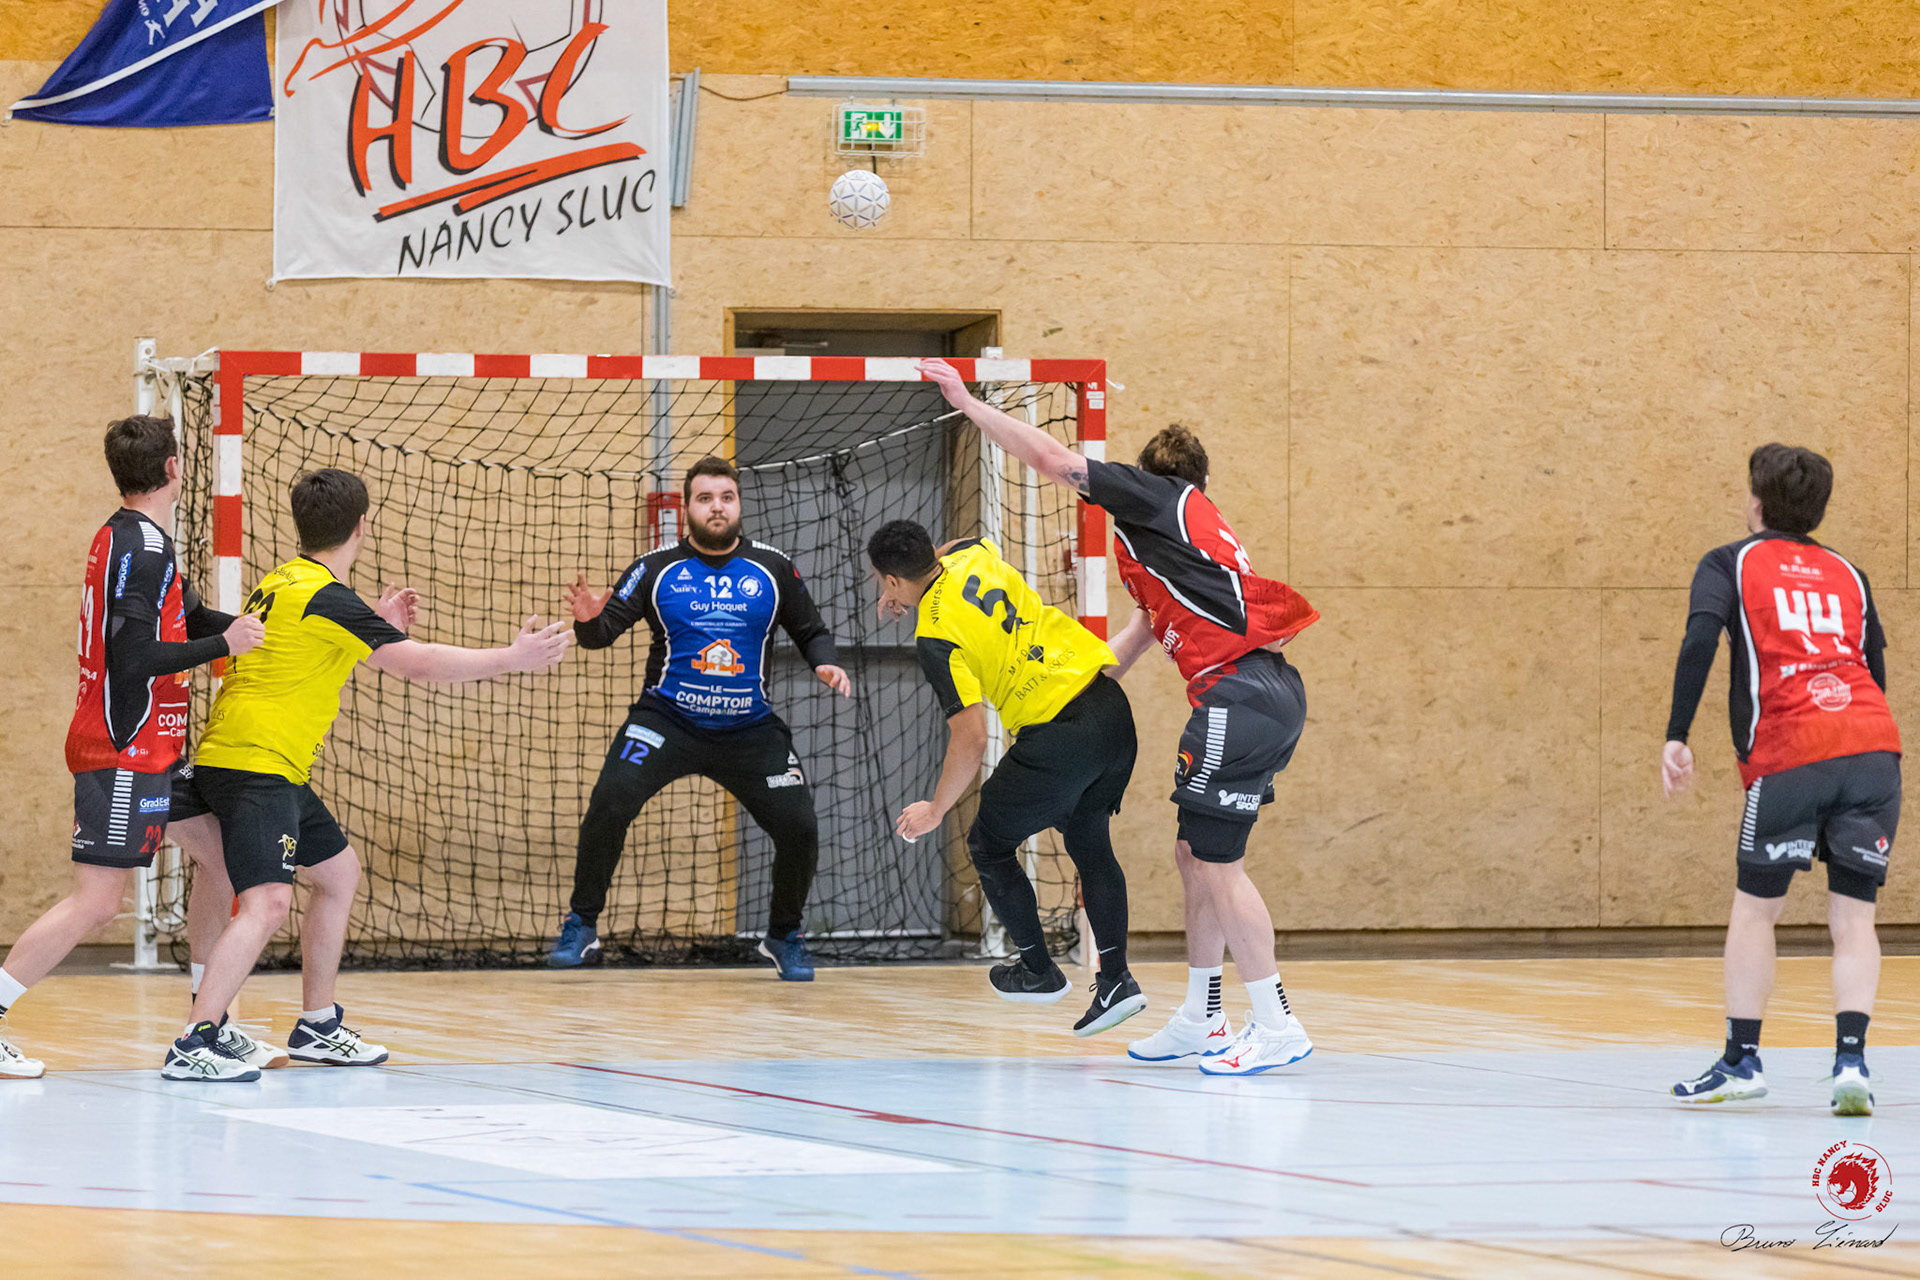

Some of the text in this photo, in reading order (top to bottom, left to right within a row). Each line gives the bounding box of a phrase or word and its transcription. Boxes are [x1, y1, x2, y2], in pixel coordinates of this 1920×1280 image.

[347, 22, 634, 198] HBC
[397, 169, 656, 275] NANCY SLUC
[704, 575, 733, 599] 12
[689, 600, 748, 613] Guy Hoquet
[962, 573, 1017, 635] 5
[1773, 586, 1852, 656] 44
[676, 691, 753, 708] COMPTOIR
[710, 685, 723, 693] LE
[1014, 677, 1040, 701] BATT
[620, 740, 649, 766] 12
